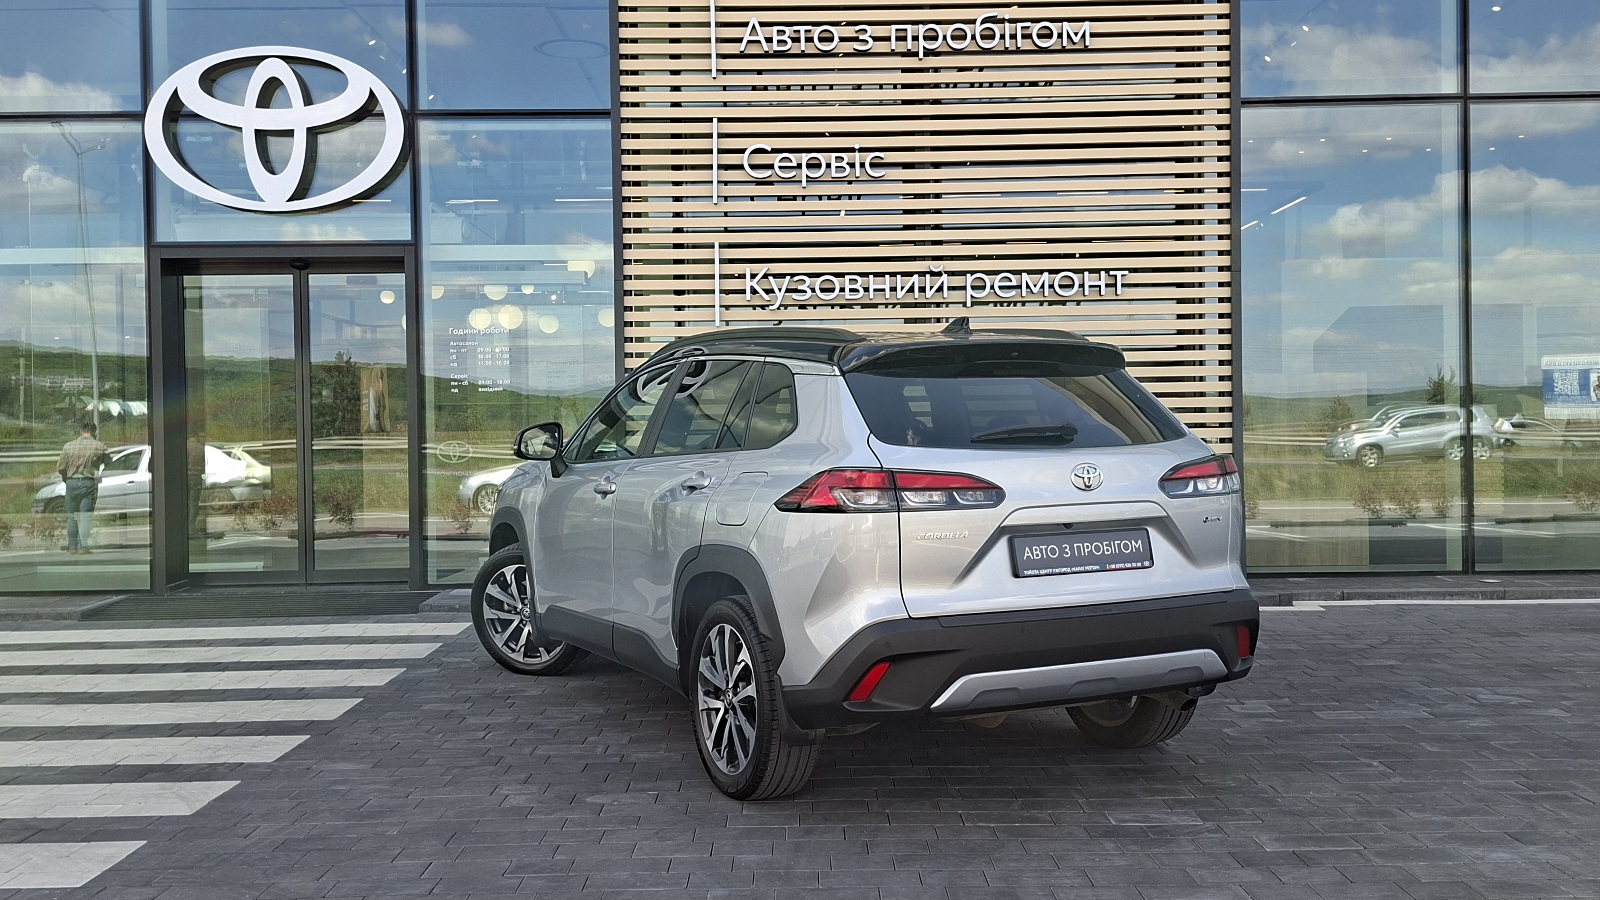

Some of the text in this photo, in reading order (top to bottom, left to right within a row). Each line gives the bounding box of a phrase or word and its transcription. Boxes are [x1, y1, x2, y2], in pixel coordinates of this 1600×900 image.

[739, 11, 1092, 60] Авто з пробігом
[742, 143, 887, 188] Сервіс
[744, 263, 1129, 311] Кузовний ремонт
[449, 327, 510, 336] Години роботи
[1023, 539, 1143, 560] АВТО З ПРОБІГОМ
